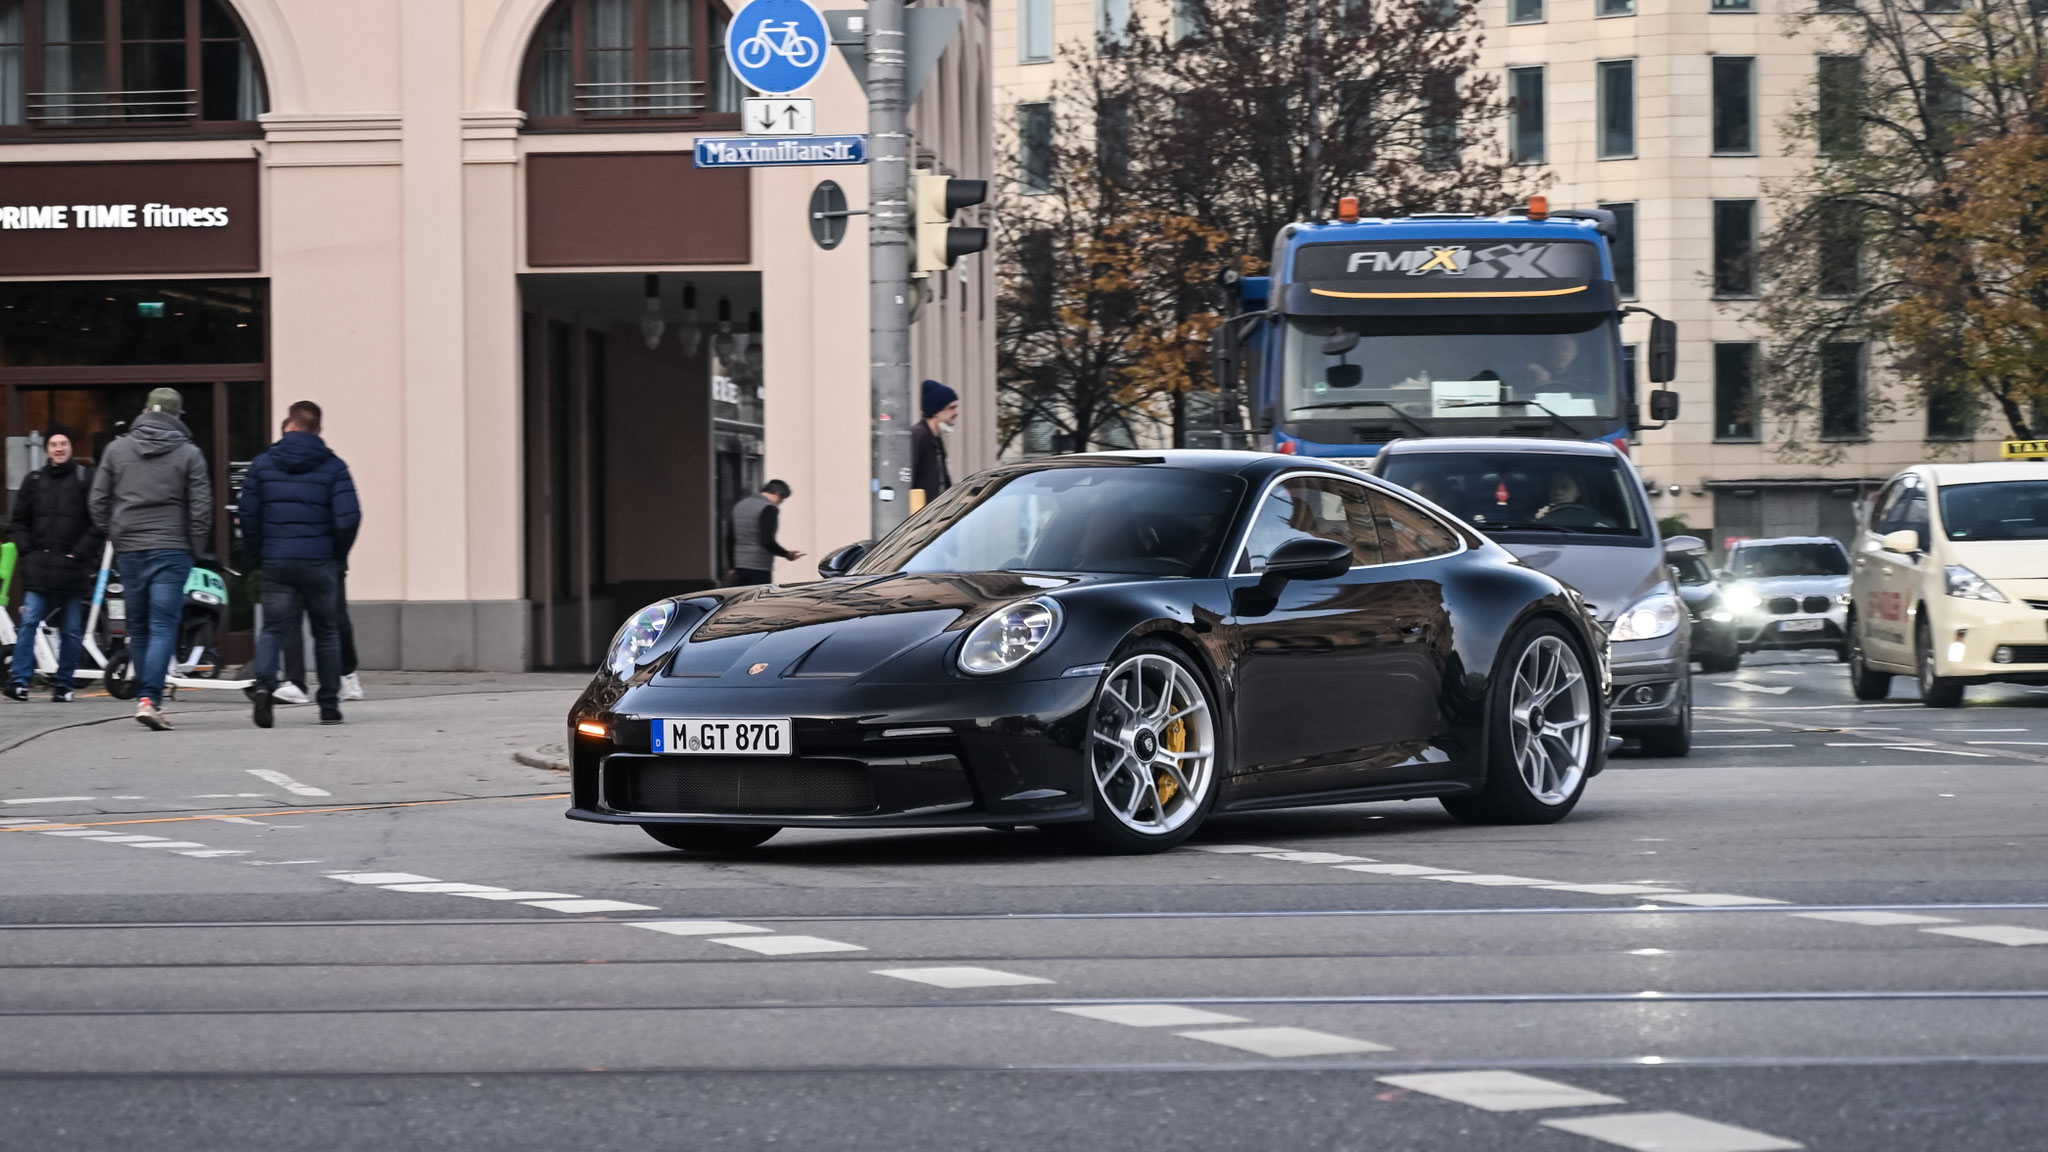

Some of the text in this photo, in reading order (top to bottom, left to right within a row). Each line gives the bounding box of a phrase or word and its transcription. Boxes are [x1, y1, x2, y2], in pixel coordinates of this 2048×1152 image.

[706, 141, 855, 163] Maximilianstr.
[0, 203, 229, 229] RIME TIME fitness
[673, 723, 780, 751] M GT 870
